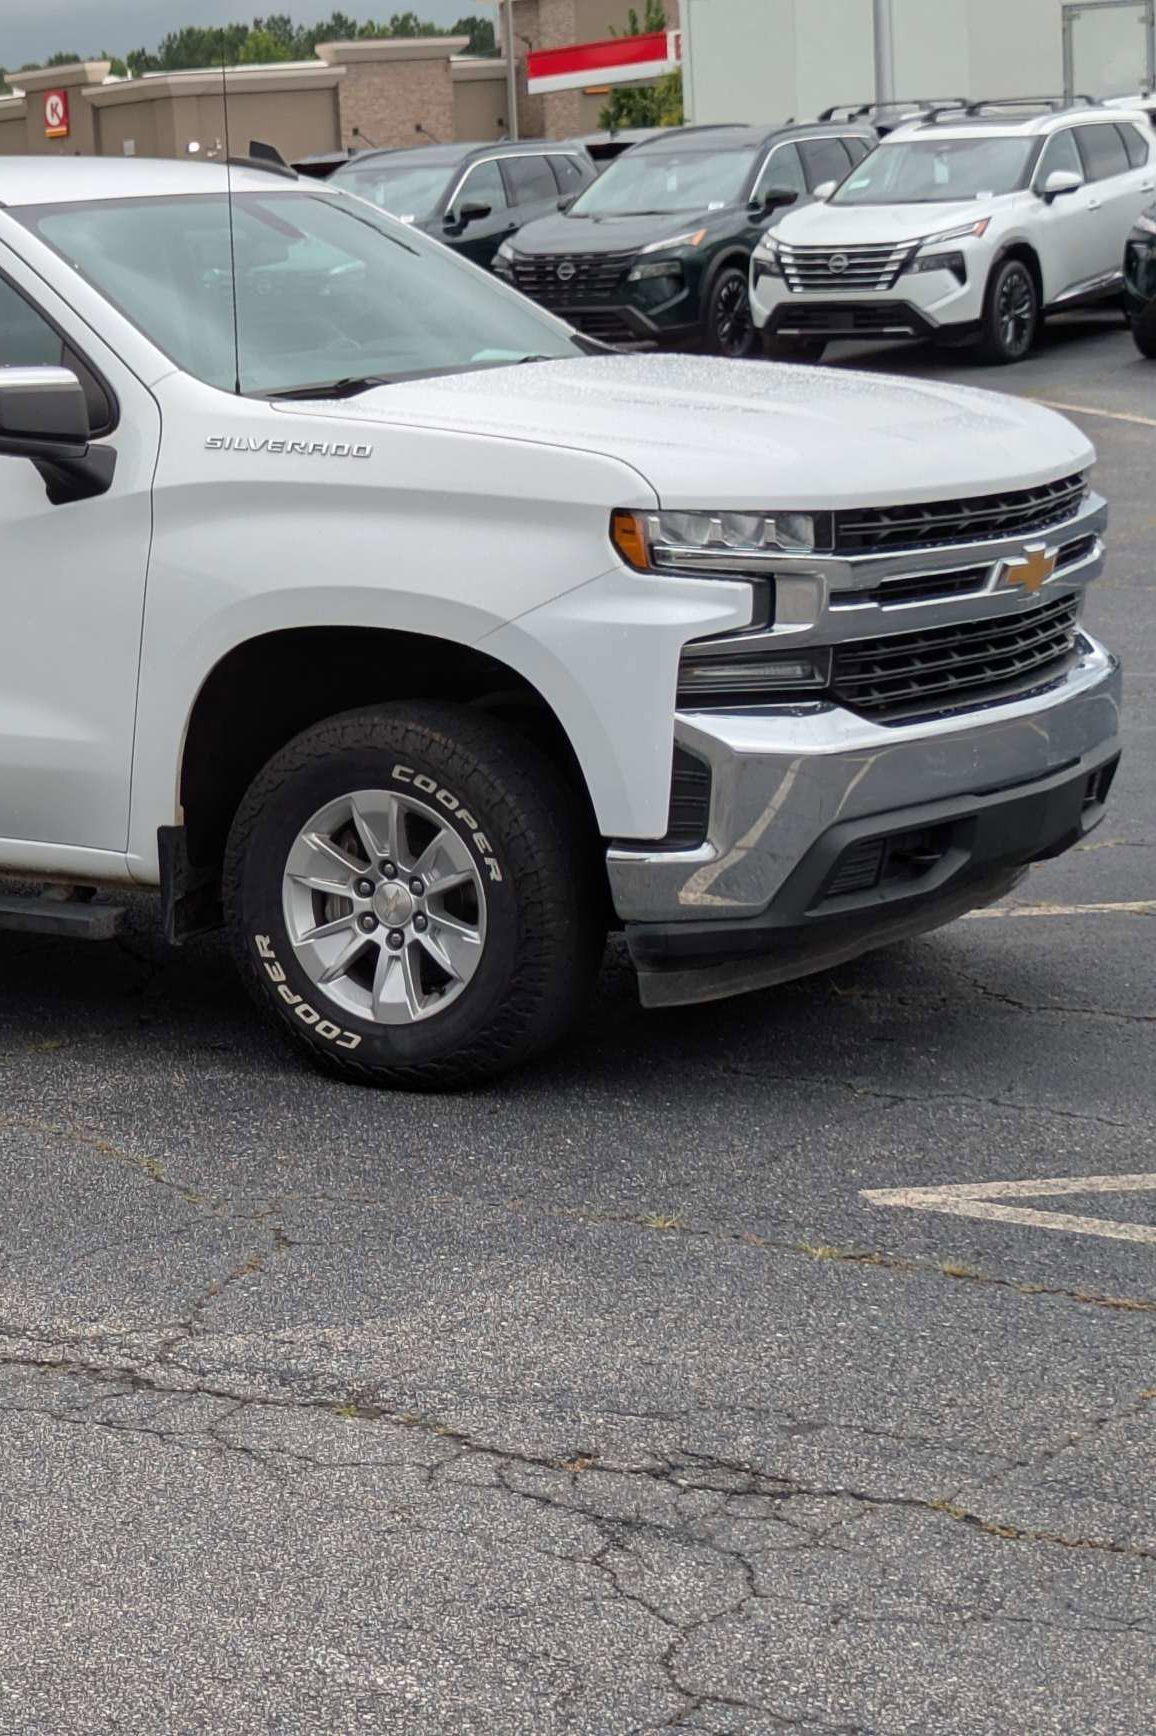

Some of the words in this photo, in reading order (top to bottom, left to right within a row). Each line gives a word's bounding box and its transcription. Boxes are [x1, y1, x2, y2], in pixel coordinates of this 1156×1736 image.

[204, 435, 373, 459] SILVERADO
[391, 764, 503, 882] COOPER
[254, 933, 362, 1050] COOPER
